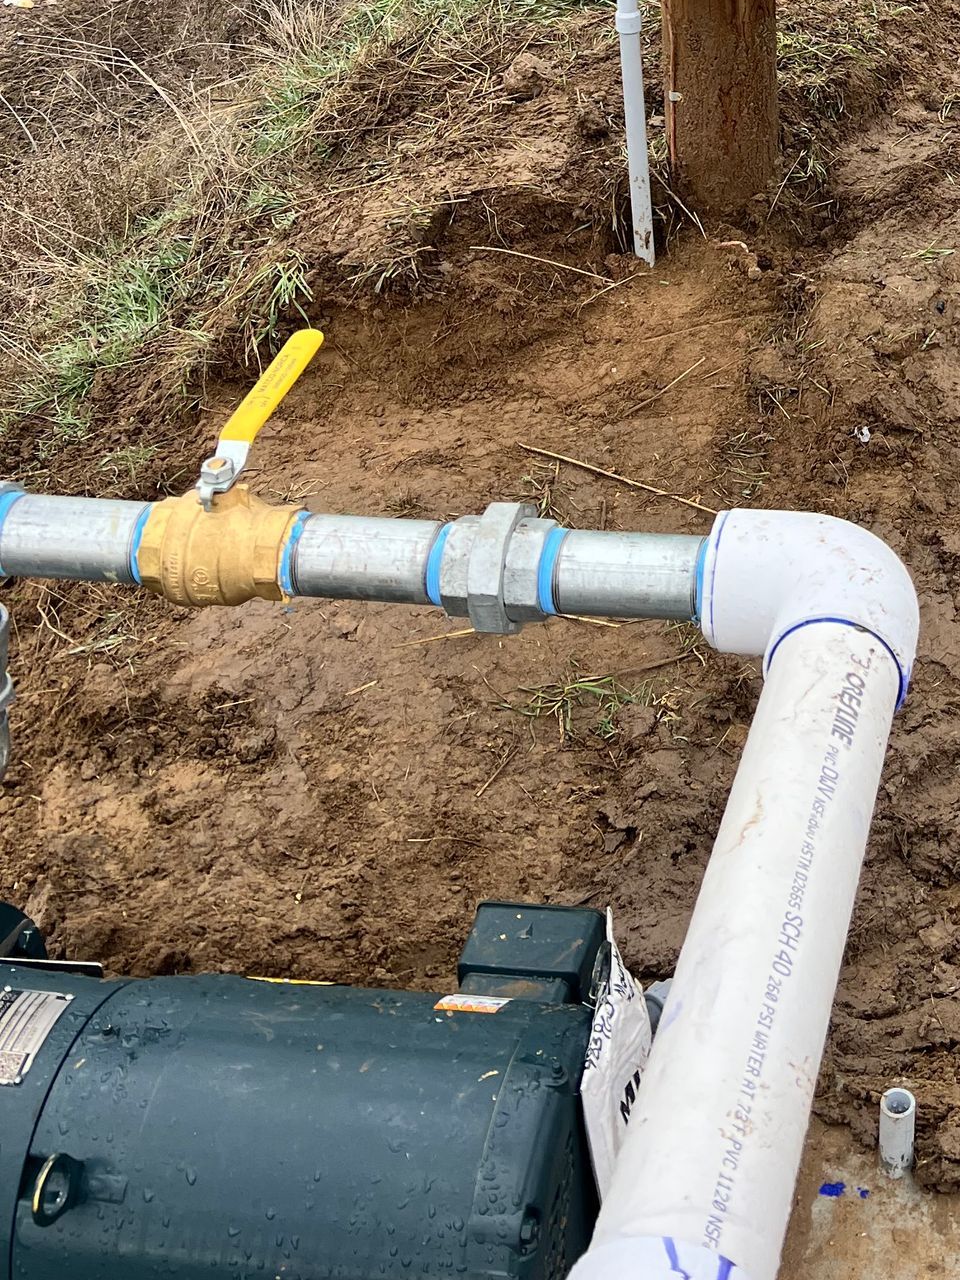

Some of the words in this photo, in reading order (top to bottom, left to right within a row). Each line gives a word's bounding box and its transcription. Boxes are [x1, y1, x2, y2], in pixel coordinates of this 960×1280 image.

[824, 744, 839, 766] PVC
[817, 765, 838, 800] DWV
[798, 840, 815, 870] ASTM
[778, 910, 803, 949] SCH
[772, 949, 793, 977] 40
[764, 975, 782, 1003] 260
[757, 1003, 775, 1030] PSI
[745, 1030, 768, 1077] WATER
[740, 1077, 756, 1100] AT
[723, 1137, 742, 1170] PVC
[712, 1171, 734, 1212] 1120
